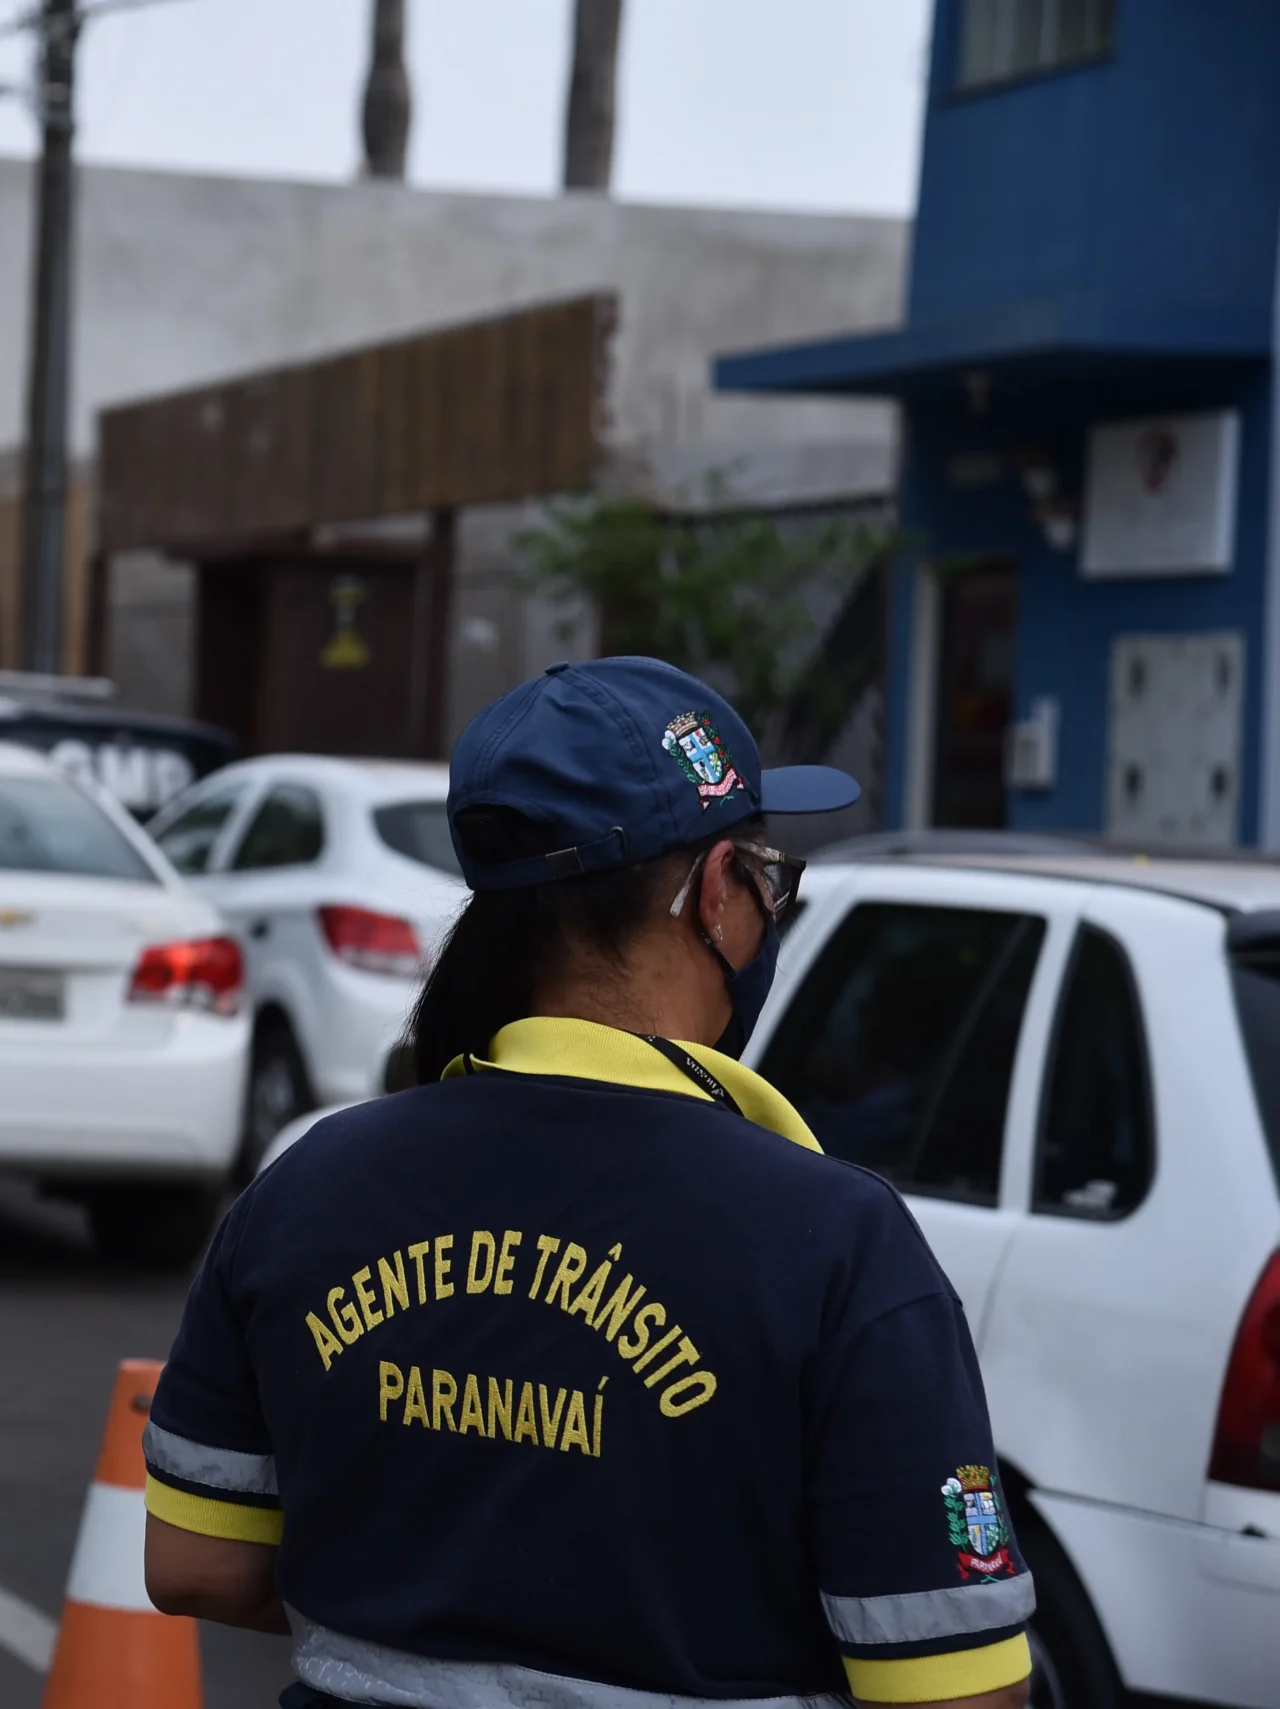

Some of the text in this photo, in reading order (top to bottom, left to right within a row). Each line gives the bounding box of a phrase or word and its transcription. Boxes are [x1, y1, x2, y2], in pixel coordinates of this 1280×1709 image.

[305, 1229, 718, 1418] AGENTE DE TRÂNSITO
[378, 1360, 609, 1458] PARANAVAÍ
